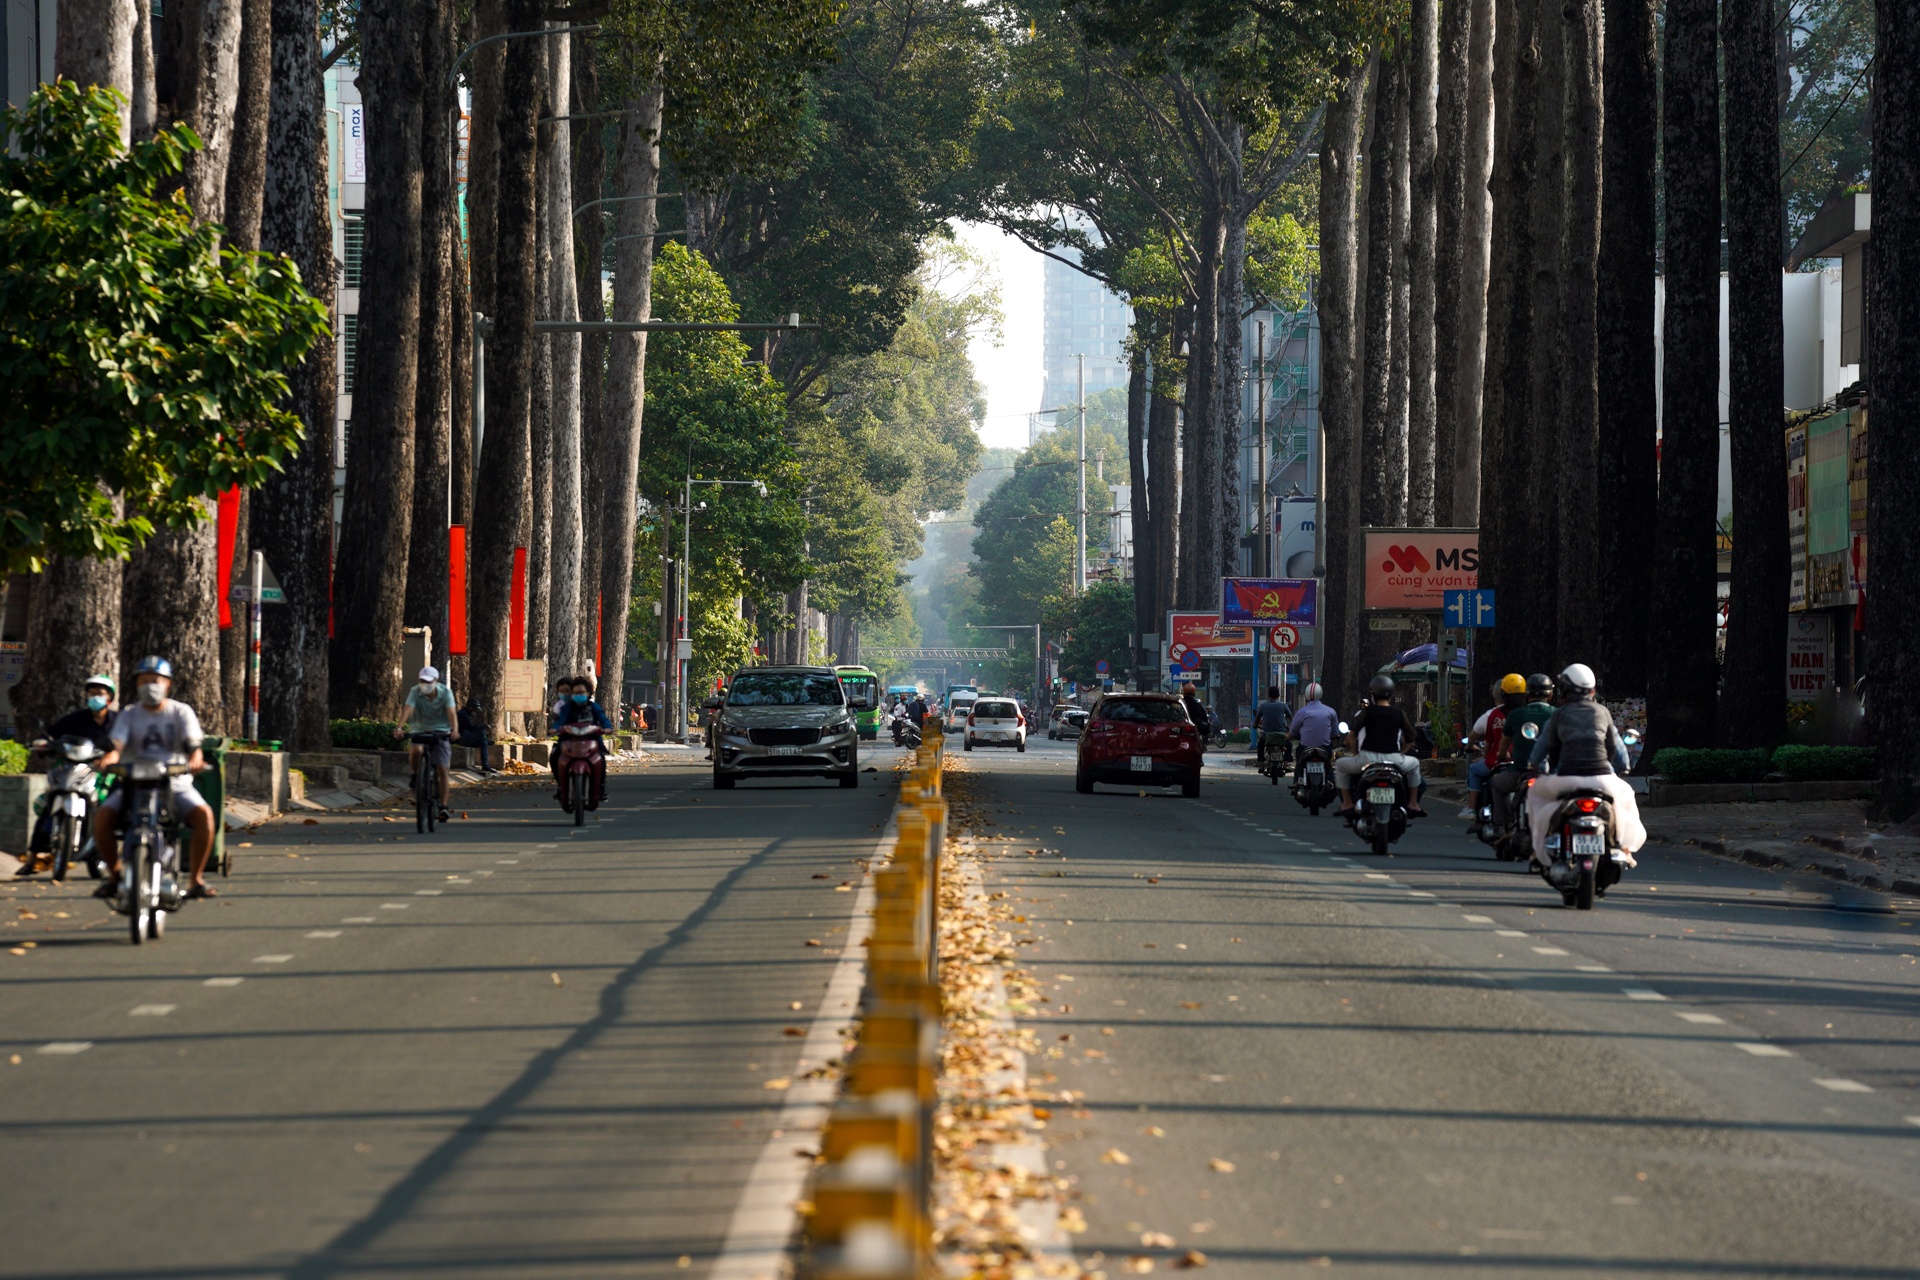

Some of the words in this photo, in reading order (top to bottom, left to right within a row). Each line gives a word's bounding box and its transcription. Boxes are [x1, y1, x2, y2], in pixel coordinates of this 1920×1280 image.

[1388, 574, 1422, 587] cùng
[1427, 576, 1462, 586] vươn
[1791, 653, 1824, 668] NAM
[1789, 670, 1826, 694] VIỆT
